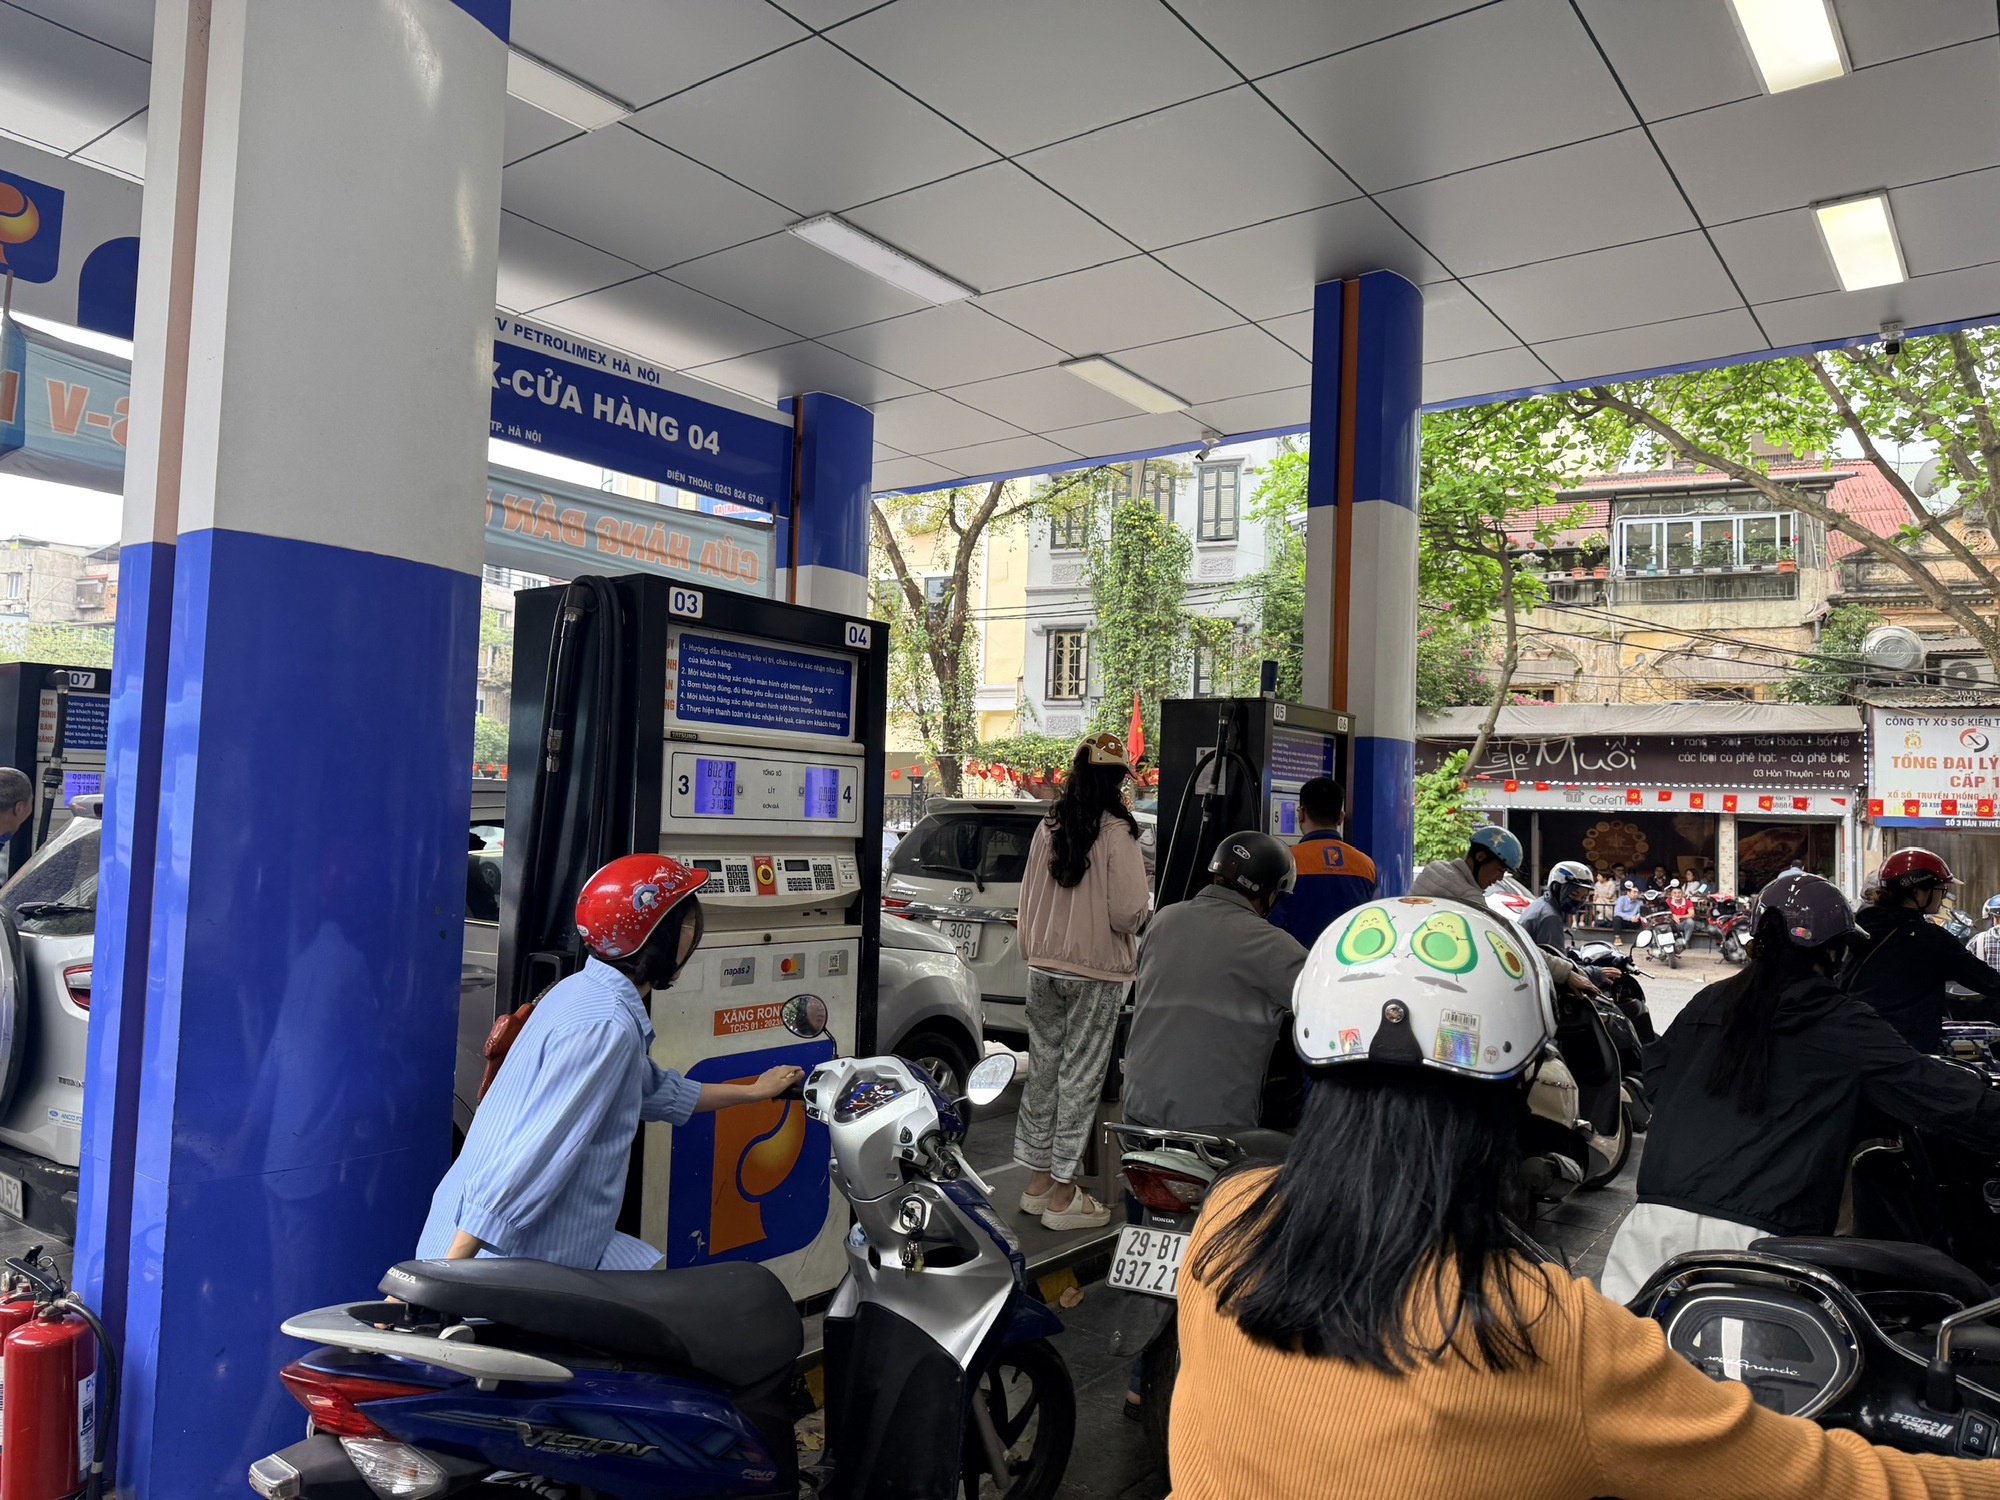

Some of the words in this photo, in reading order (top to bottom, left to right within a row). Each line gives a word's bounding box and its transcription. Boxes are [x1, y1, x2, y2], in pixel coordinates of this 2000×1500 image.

[495, 317, 507, 332] V
[514, 323, 606, 366] PETROLIMEX
[612, 358, 631, 375] HÀ
[637, 366, 660, 386] NỘI
[593, 393, 680, 442] HÀNG
[687, 425, 720, 456] 04
[508, 424, 522, 438] HÀ
[525, 429, 542, 445] NỘI
[666, 469, 686, 484] ĐIỆN
[688, 475, 713, 492] THOẠI:
[715, 483, 731, 496] 0243
[734, 488, 746, 500] 824
[748, 494, 764, 505] 6745
[674, 591, 698, 614] 03
[848, 626, 868, 645] 04
[682, 642, 688, 650] 1.
[721, 649, 738, 658] khách
[700, 658, 717, 667] khách
[70, 672, 91, 686] 07
[681, 666, 687, 675] 2.
[700, 670, 717, 679] khách
[680, 691, 686, 699] 4.
[698, 694, 716, 703] khách
[1274, 706, 1285, 718] 05
[1885, 716, 1914, 726] CÔNG
[1916, 718, 1930, 726] TY
[1933, 713, 1948, 726] XỔ
[1951, 714, 1965, 726] SỐ
[1968, 714, 1992, 727] KIẾN
[1338, 718, 1347, 730] 06
[1678, 752, 1696, 763] các
[1736, 752, 1755, 765] phê
[1758, 752, 1778, 765] hạt
[1790, 752, 1804, 763] cà
[1807, 752, 1827, 765] phê
[1891, 752, 1938, 770] TỔNG
[1943, 756, 1973, 773] ĐẠI
[1978, 754, 2000, 770] LÝ
[708, 761, 734, 778] 80212
[1766, 769, 1782, 778] Hàn
[1786, 769, 1814, 778] Thuyên
[1822, 769, 1835, 778] Hà
[678, 775, 690, 795] 3
[1950, 772, 1986, 788] CẤP
[1992, 776, 2000, 788] 1
[842, 786, 852, 804] 4
[1274, 811, 1280, 824] 5
[949, 922, 972, 939] 30G
[724, 966, 745, 977] napas
[722, 1009, 754, 1025] XĂNG
[757, 1006, 780, 1018] RON
[730, 1022, 750, 1034] TCCS
[750, 1022, 758, 1031] 01
[1152, 1216, 1176, 1224] HONDA
[1126, 1230, 1182, 1262] 29-B1
[1112, 1258, 1180, 1292] 937.21
[502, 1418, 660, 1457] VISION
